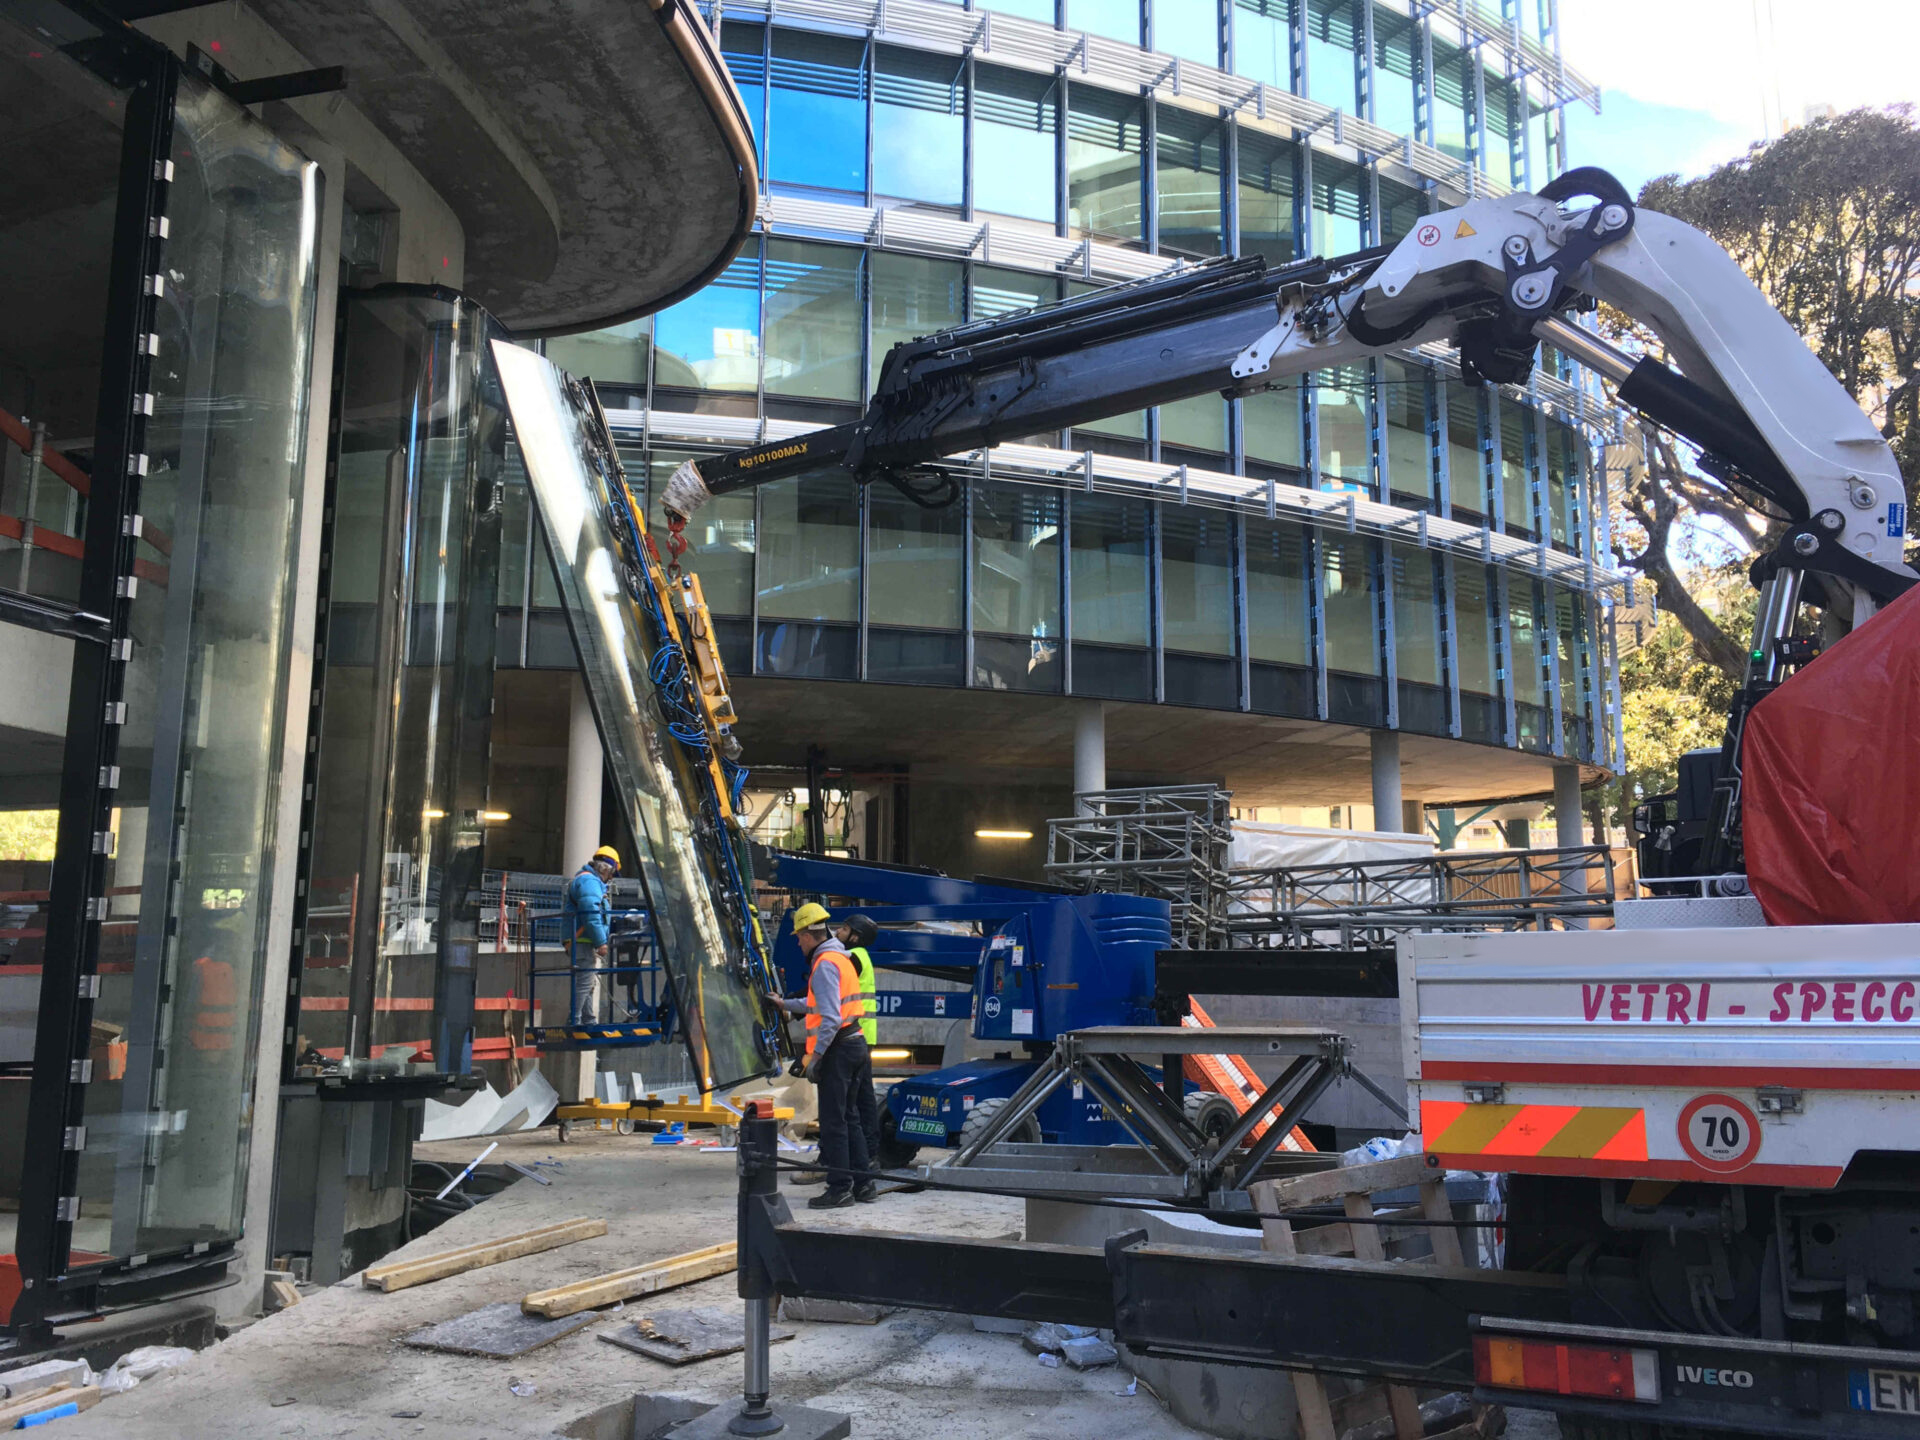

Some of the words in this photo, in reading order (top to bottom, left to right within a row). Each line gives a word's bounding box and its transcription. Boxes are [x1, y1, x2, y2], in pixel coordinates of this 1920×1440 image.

[739, 443, 807, 468] kg10100MAX
[1582, 983, 1711, 1024] VETRI
[1728, 1005, 1746, 1015] -
[1769, 982, 1915, 1022] SPECC
[1701, 1116, 1740, 1148] 70
[1676, 1365, 1754, 1389] IVECO
[1873, 1373, 1920, 1411] EM
